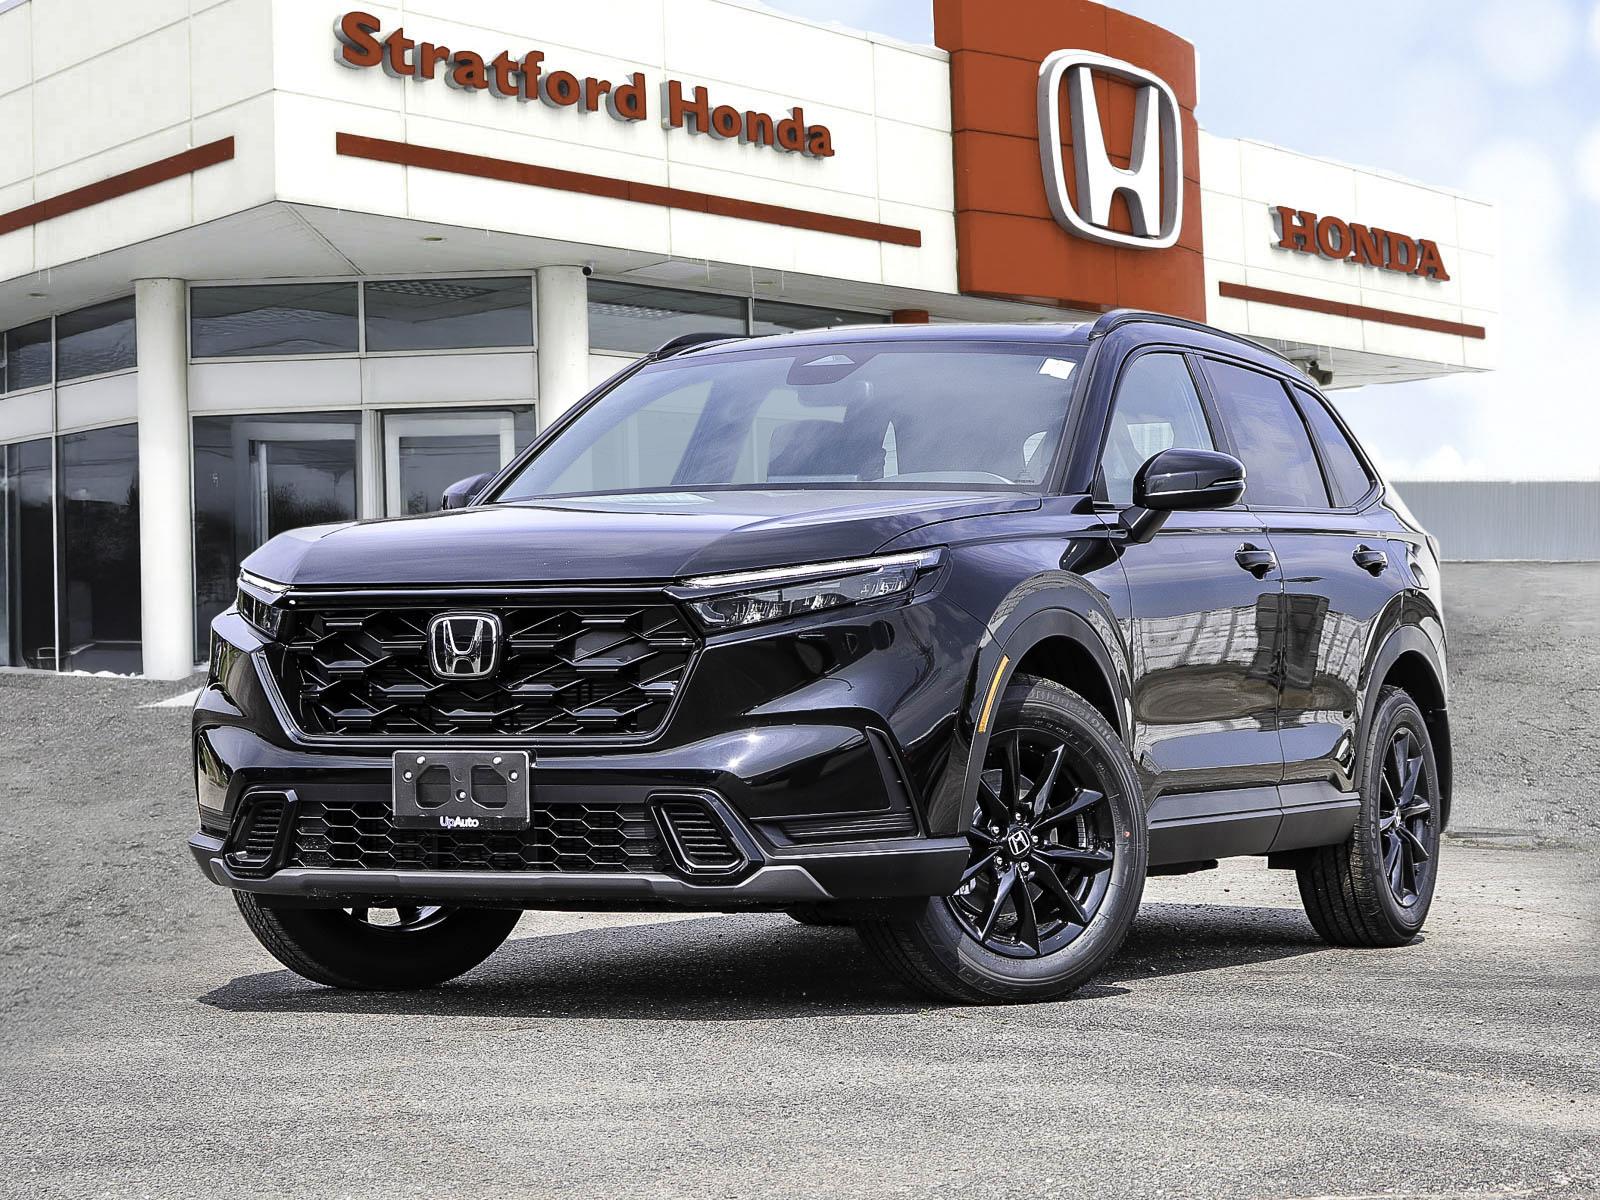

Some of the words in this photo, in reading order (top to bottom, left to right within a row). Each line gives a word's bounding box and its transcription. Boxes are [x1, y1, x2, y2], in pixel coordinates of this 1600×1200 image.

[336, 11, 647, 122] Stratford
[663, 80, 835, 158] Honda
[1272, 205, 1450, 281] HONDA
[440, 816, 480, 829] UpAuto
